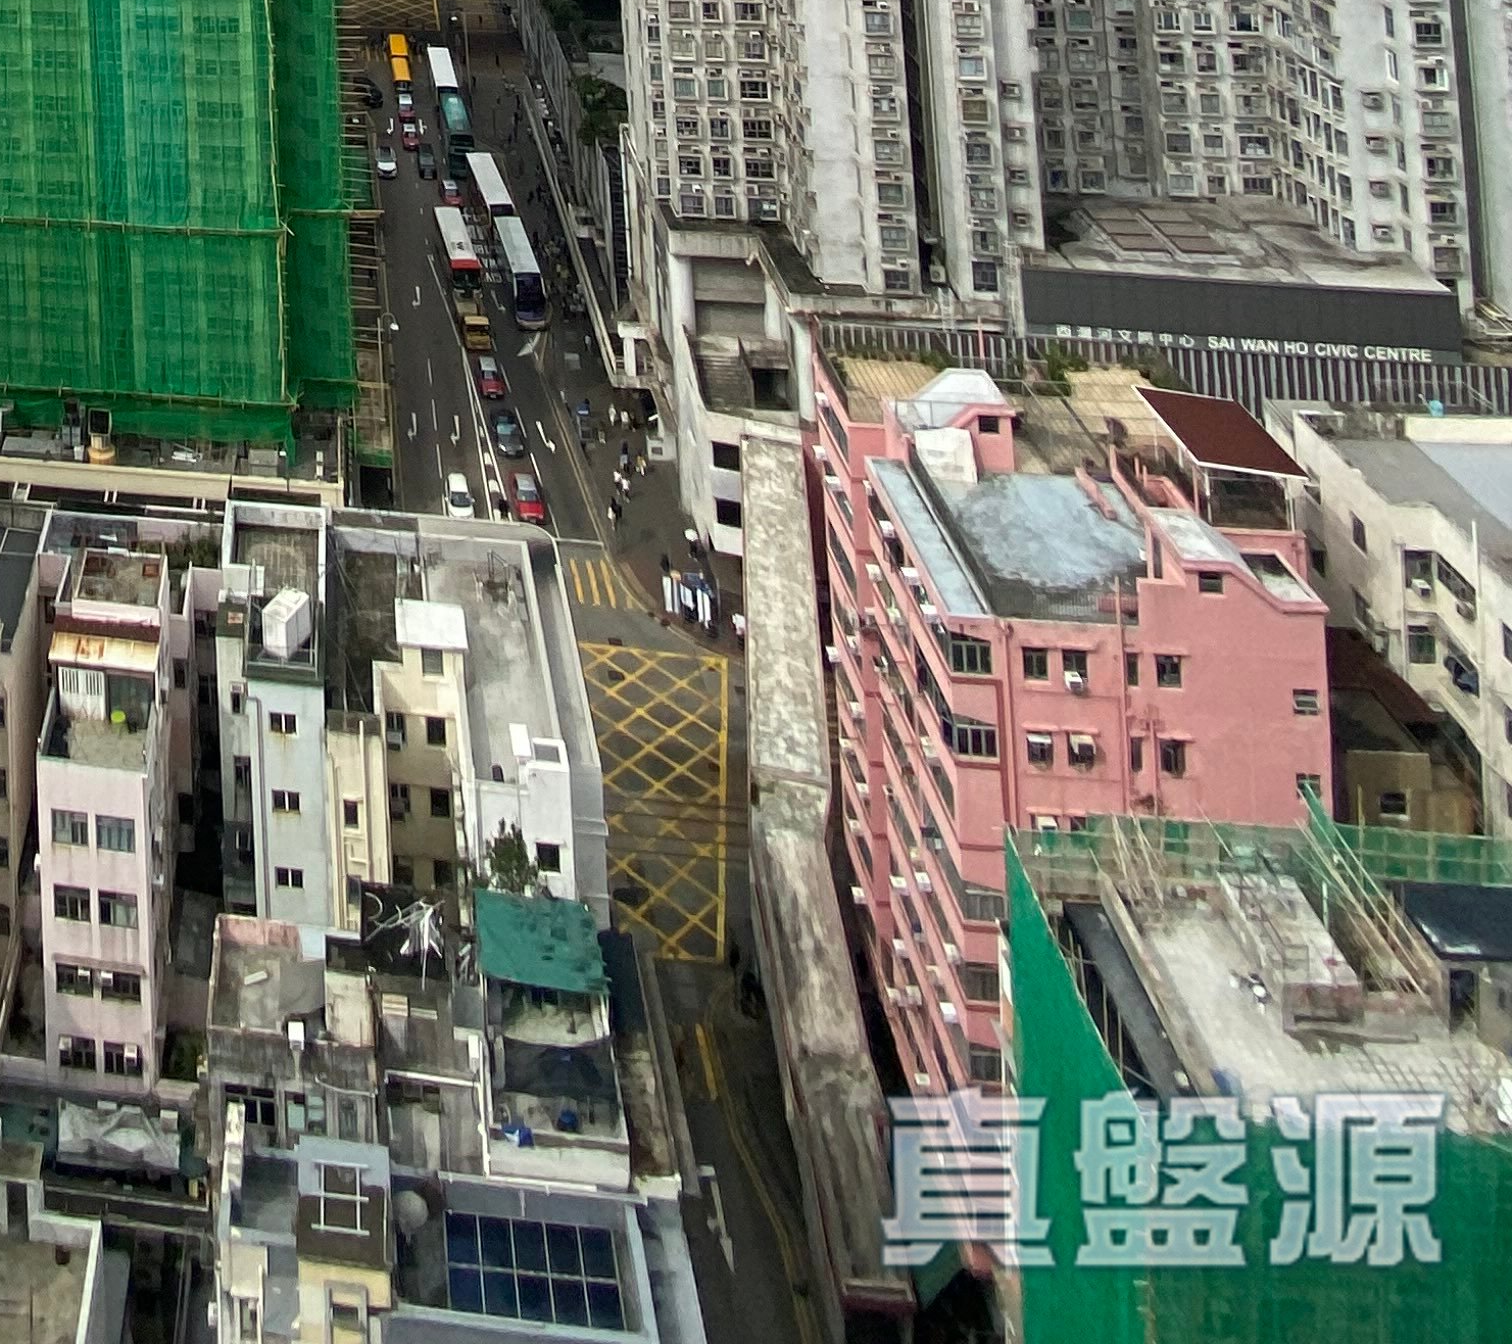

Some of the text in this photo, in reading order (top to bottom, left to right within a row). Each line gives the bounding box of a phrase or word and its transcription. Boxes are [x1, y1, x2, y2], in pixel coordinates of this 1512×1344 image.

[1207, 335, 1433, 363] SAI WAN HO CIVIC CENTRE
